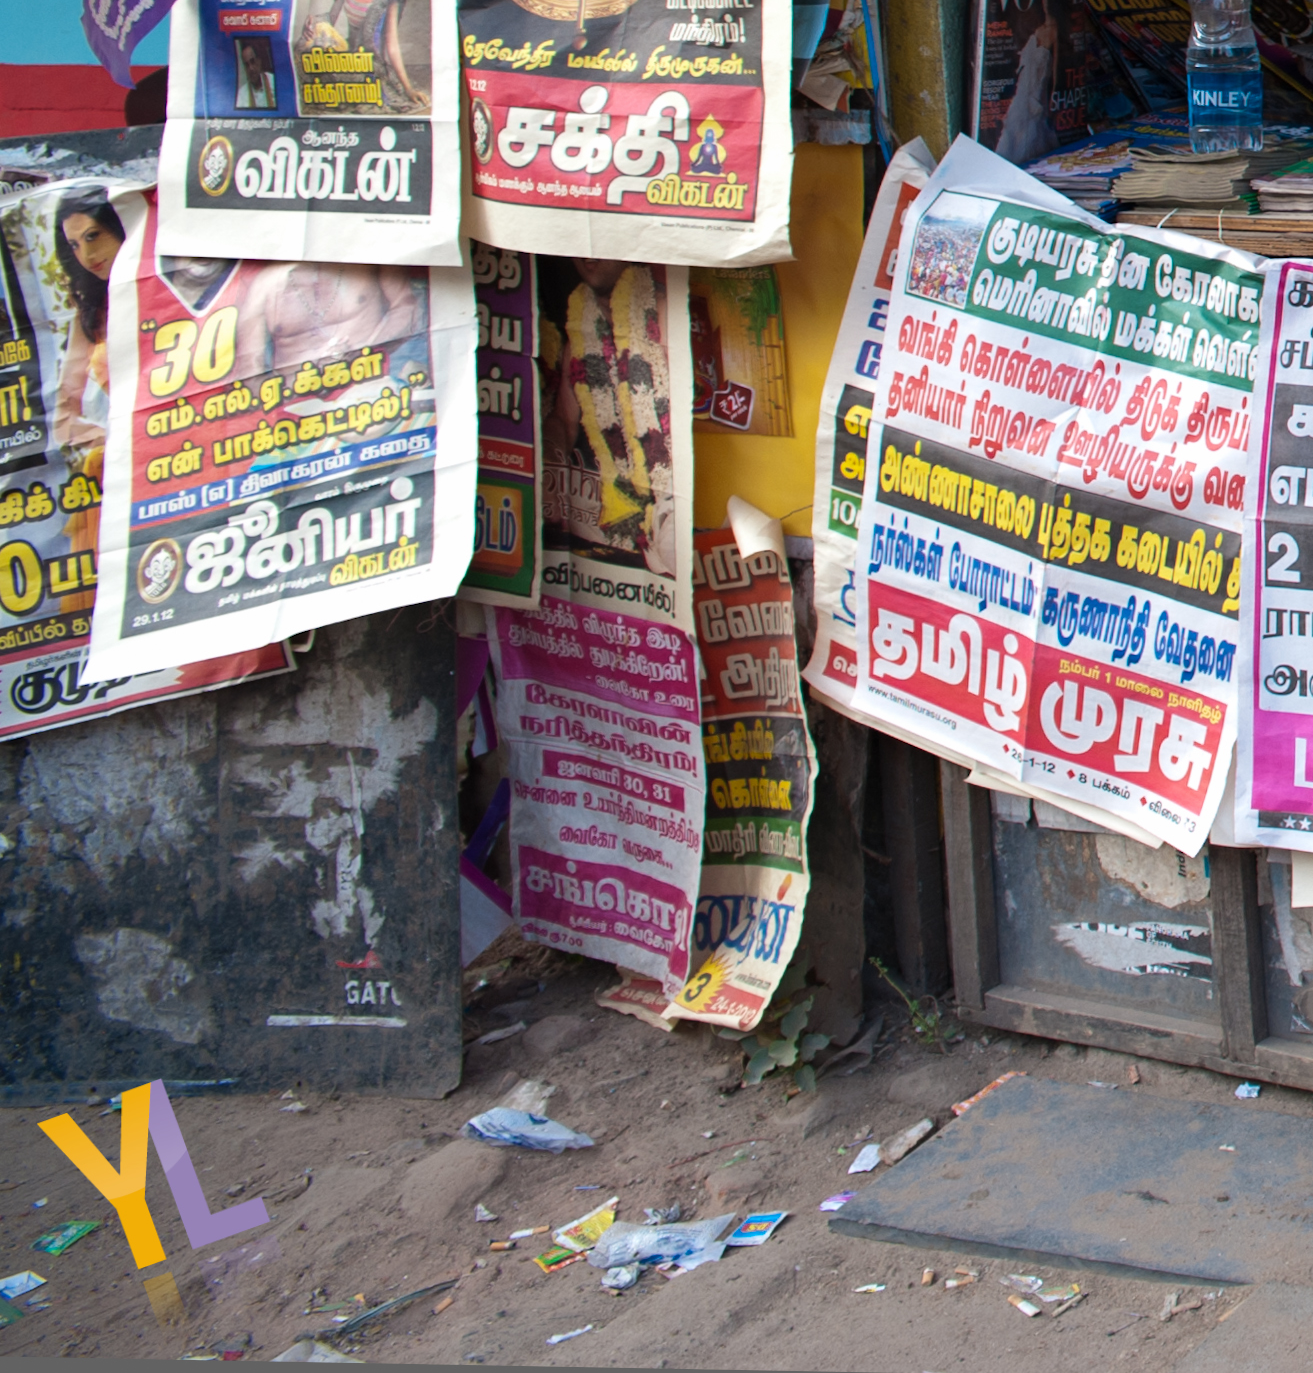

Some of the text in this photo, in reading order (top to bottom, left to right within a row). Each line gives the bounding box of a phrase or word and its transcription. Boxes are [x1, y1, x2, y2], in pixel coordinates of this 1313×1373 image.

[1191, 89, 1251, 109] KINLEY
[302, 128, 360, 149] ஆனந்த
[497, 85, 690, 206] சக்தி
[235, 126, 417, 203] விகடன்
[646, 172, 749, 211] விகடன்
[972, 267, 1113, 343] மெரினாவில்
[897, 310, 959, 368] வங்கி
[146, 441, 204, 484] என்
[359, 433, 432, 463] கதை
[184, 476, 423, 596] ஜூனியர்
[1265, 530, 1301, 585] 2
[329, 535, 420, 588] விகடன்
[866, 683, 959, 731] www.tamilmurasu.org
[869, 606, 1215, 794] தமிழ் முரசு
[1114, 673, 1165, 701] மாலை
[525, 680, 693, 746] கேரளாவின்
[512, 778, 578, 810] சென்னை
[556, 755, 623, 788] ஜனவரி
